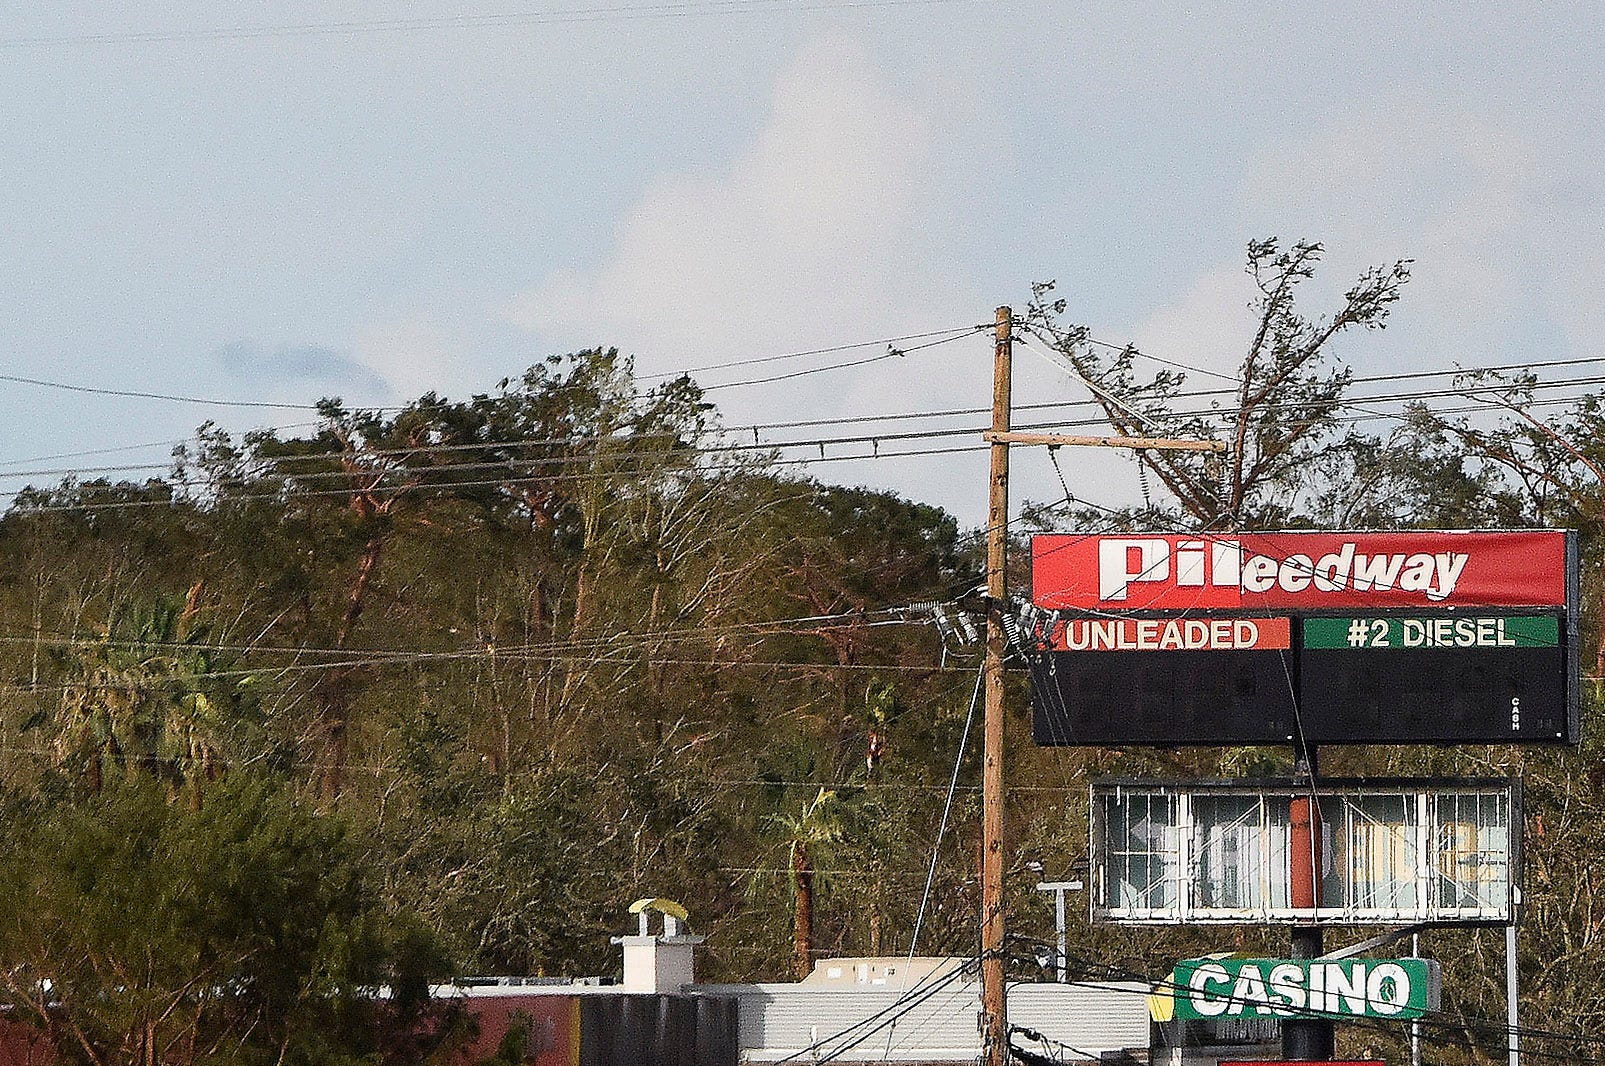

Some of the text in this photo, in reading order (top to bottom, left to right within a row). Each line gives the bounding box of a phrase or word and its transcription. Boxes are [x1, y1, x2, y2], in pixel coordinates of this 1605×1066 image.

[1066, 620, 1259, 649] UNLEADED
[1347, 618, 1515, 647] #2 DIESEL
[1511, 697, 1520, 731] CASH
[1188, 962, 1411, 1017] CASINO
